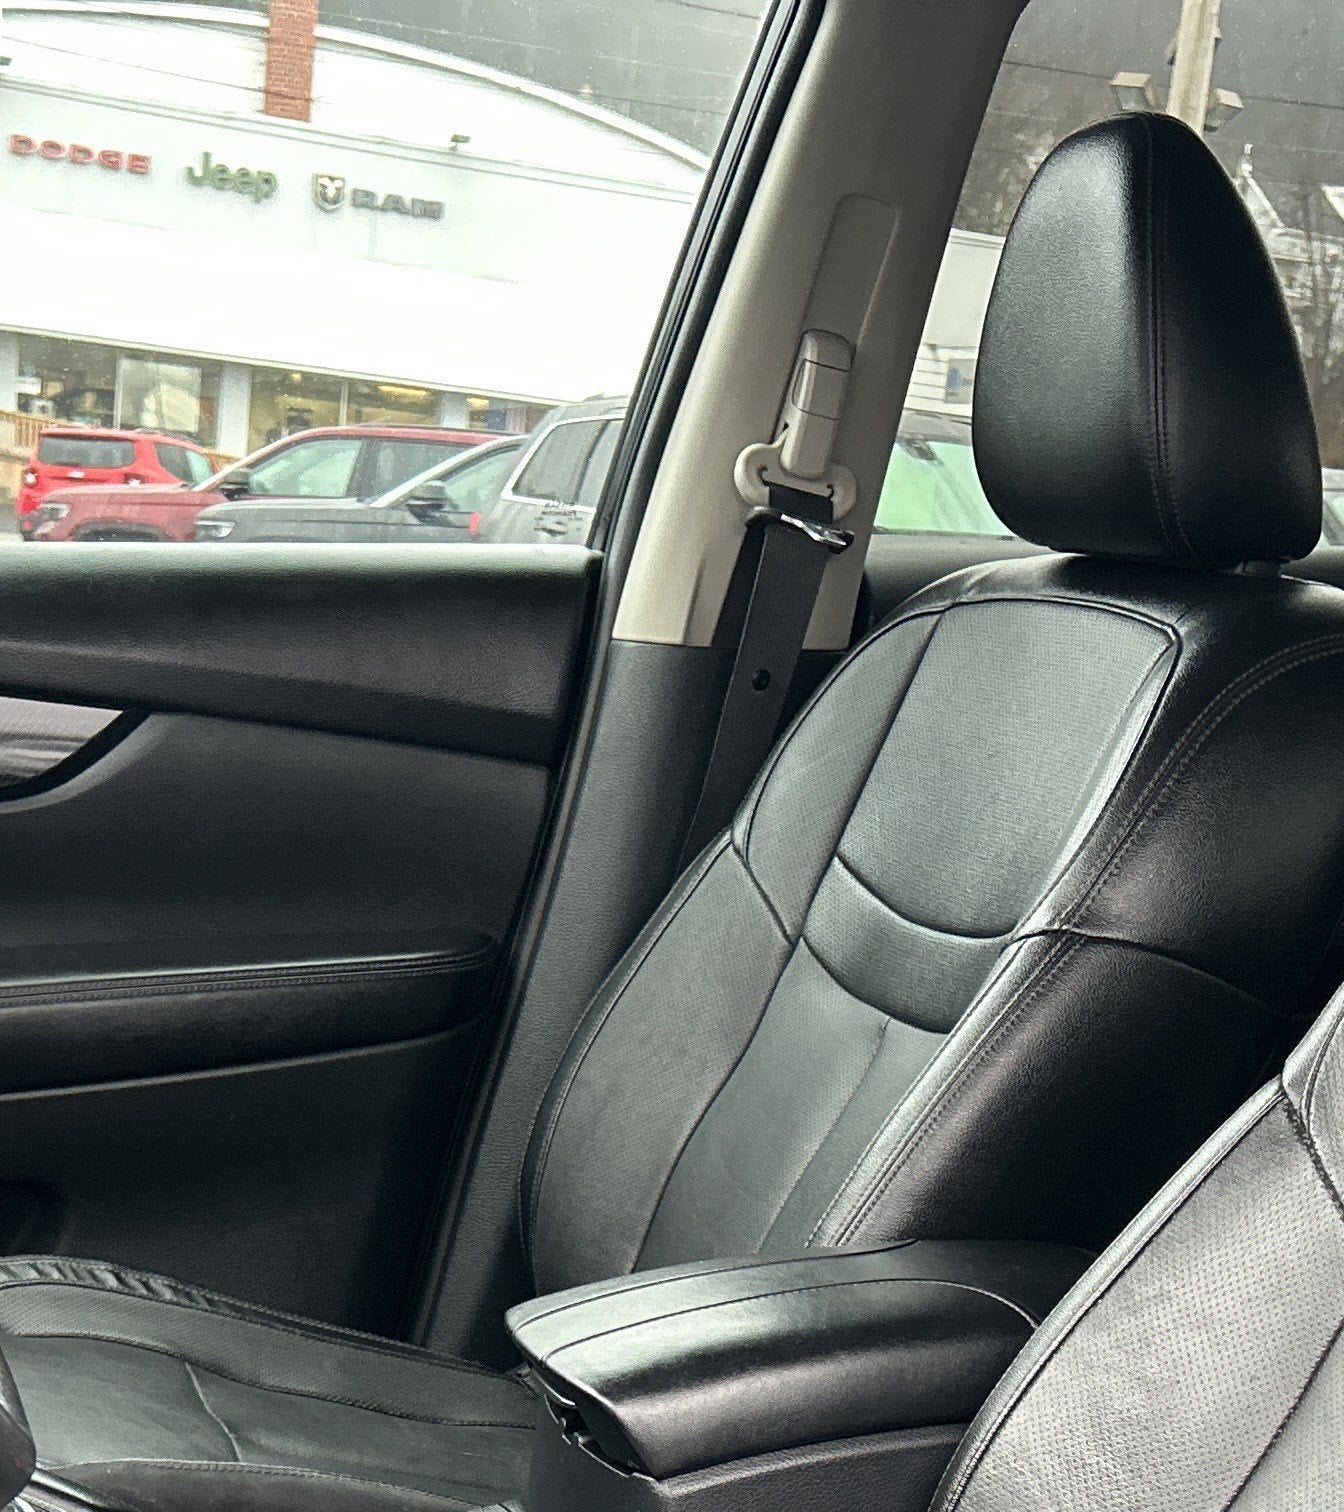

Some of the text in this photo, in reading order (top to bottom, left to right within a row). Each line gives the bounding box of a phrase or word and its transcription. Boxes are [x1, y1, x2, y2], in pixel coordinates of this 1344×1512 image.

[9, 133, 153, 175] DODGE
[185, 151, 278, 203] Jeep
[351, 186, 445, 220] RAM
